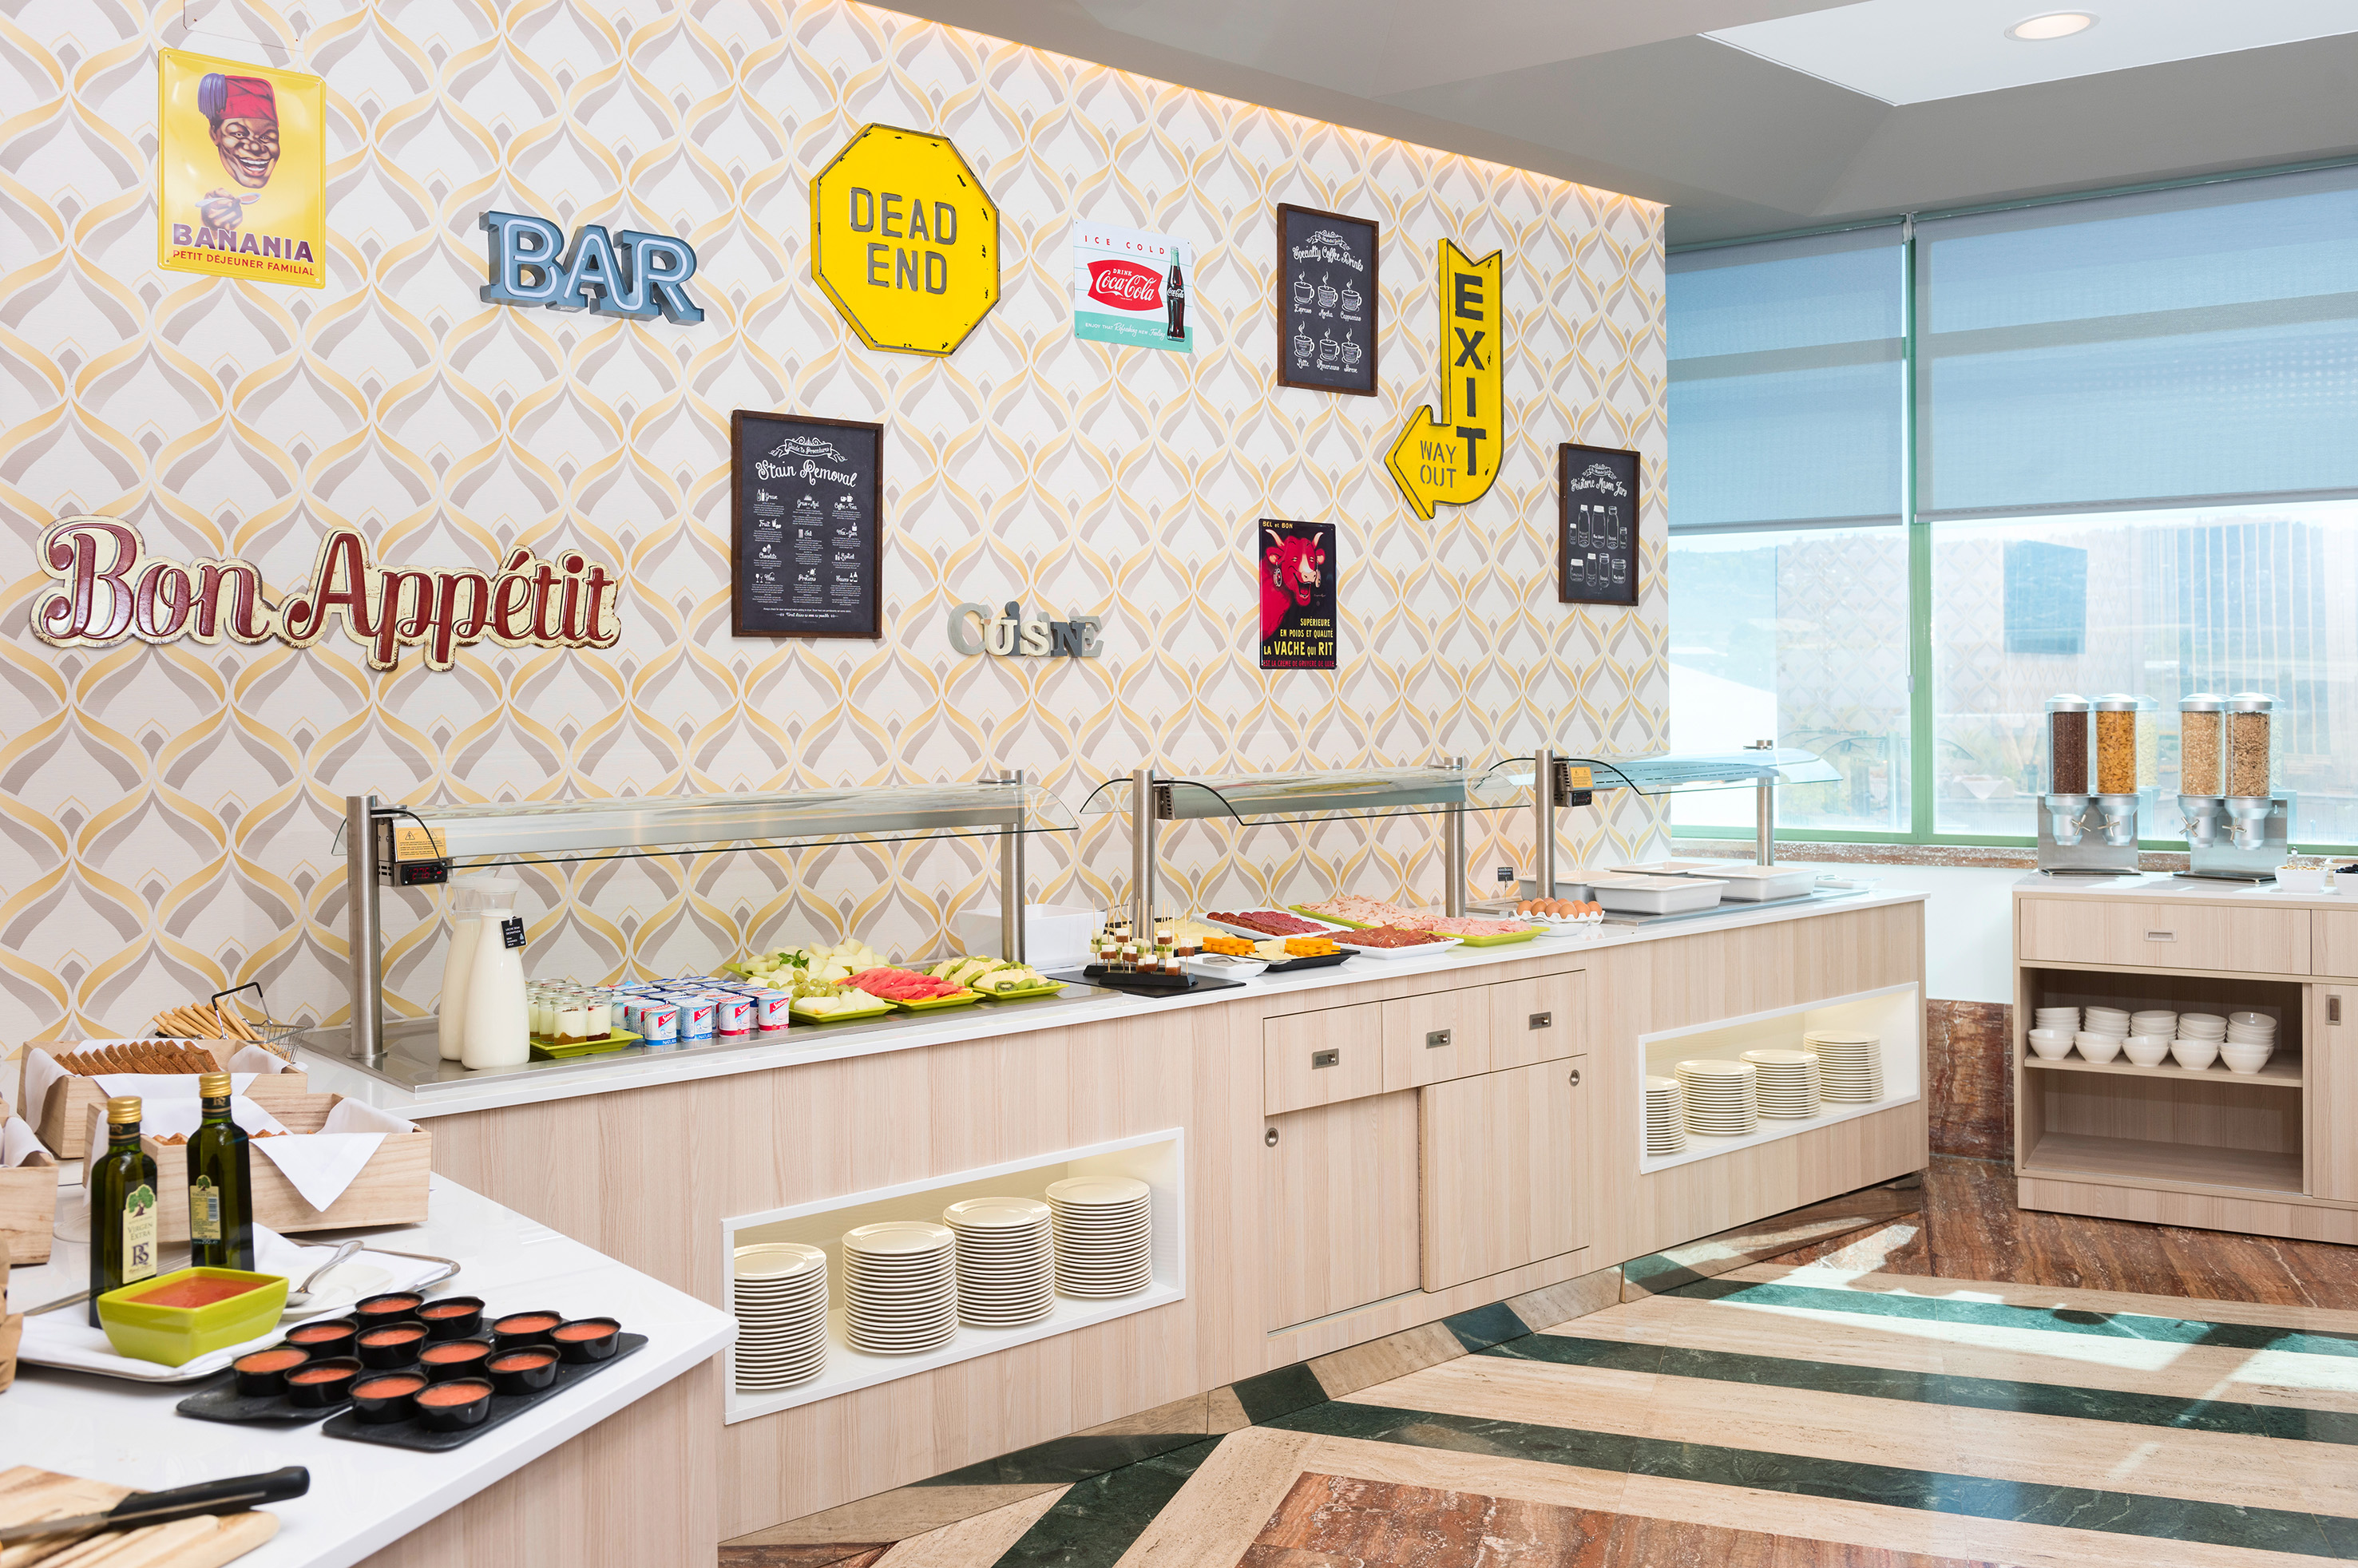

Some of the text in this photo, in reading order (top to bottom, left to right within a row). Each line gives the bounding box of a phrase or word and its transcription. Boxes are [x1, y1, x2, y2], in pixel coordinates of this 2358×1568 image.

[849, 185, 957, 246] DEAD
[172, 223, 315, 263] BANANIA
[1084, 235, 1165, 255] ICE COLD
[172, 250, 315, 276] PETIT DÉJEUNER FAMILIAL
[480, 211, 704, 324] BAR
[866, 243, 949, 295] END
[1292, 245, 1364, 272] Specialty Coffee Drinks
[1095, 269, 1158, 302] Coca-Cola
[1113, 268, 1133, 277] DRINK
[1114, 322, 1138, 338] Refreshing
[1149, 328, 1166, 341] Feeling
[1453, 271, 1488, 477] EXIT
[1420, 439, 1457, 465] WAY
[755, 459, 858, 487] Stain Removal
[1419, 464, 1457, 489] OUT
[1571, 476, 1627, 497] Historic Mason Jars
[40, 521, 619, 669] Bon Appétit
[1280, 629, 1287, 637] EN
[1289, 629, 1305, 638] POIDS
[1313, 628, 1334, 639] QUALITÉ
[1300, 616, 1331, 627] SUPÉRIEURE
[1263, 641, 1334, 657] LA VACHE QUI RIT
[127, 1222, 153, 1233] VIRGEN
[130, 1230, 151, 1241] EXTRA
